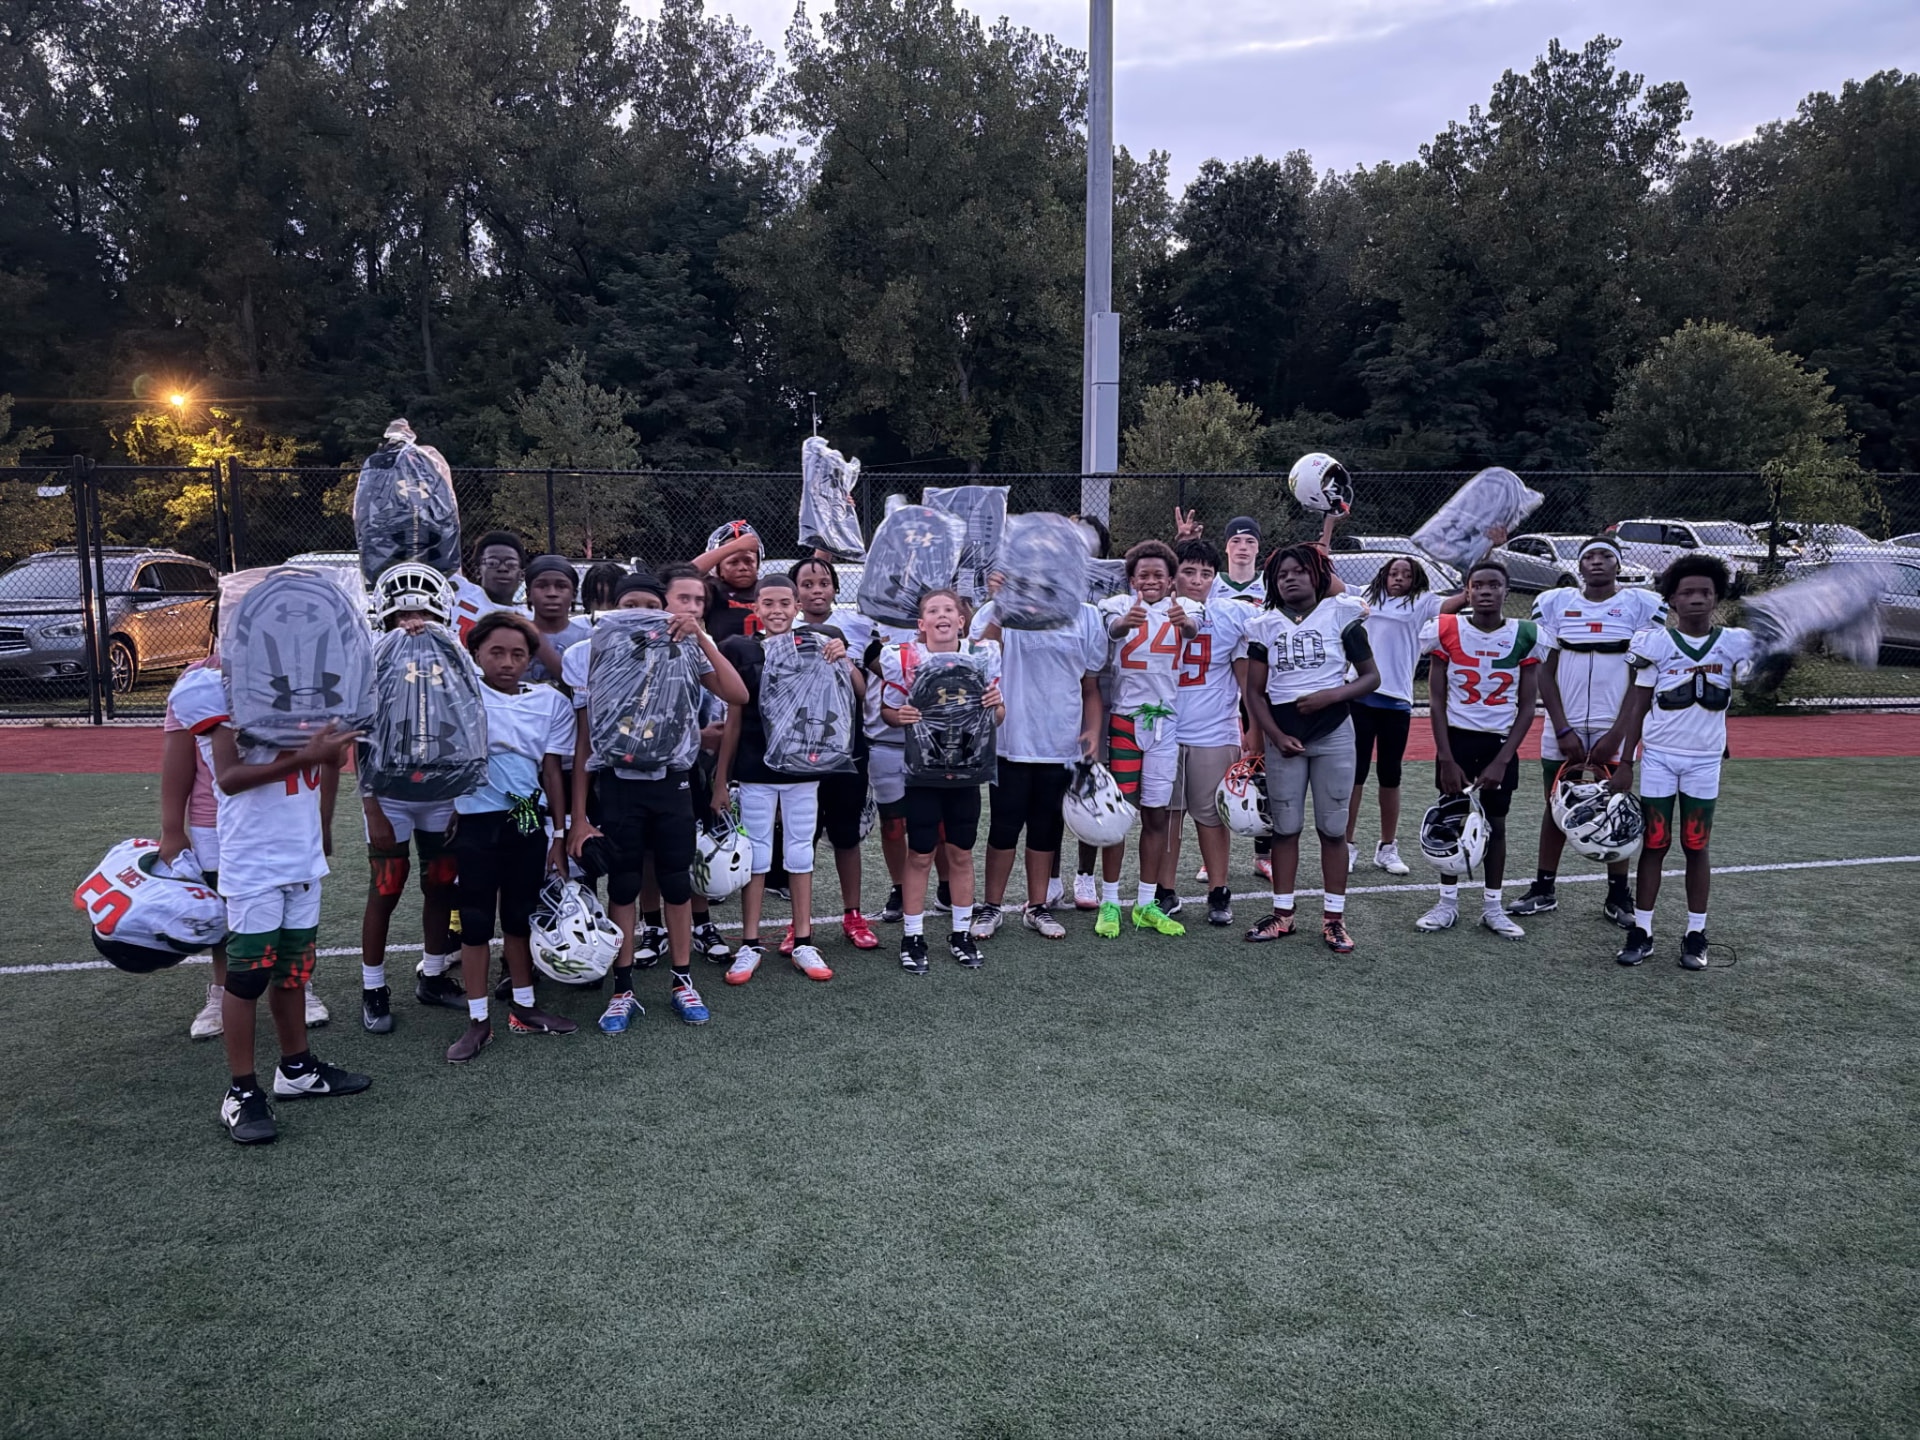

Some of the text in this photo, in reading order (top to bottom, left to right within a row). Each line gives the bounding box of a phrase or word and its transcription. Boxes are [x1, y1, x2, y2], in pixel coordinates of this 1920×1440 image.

[1120, 621, 1182, 670] 24
[1178, 633, 1212, 687] 9
[1274, 629, 1326, 673] 10
[1453, 669, 1514, 706] 32
